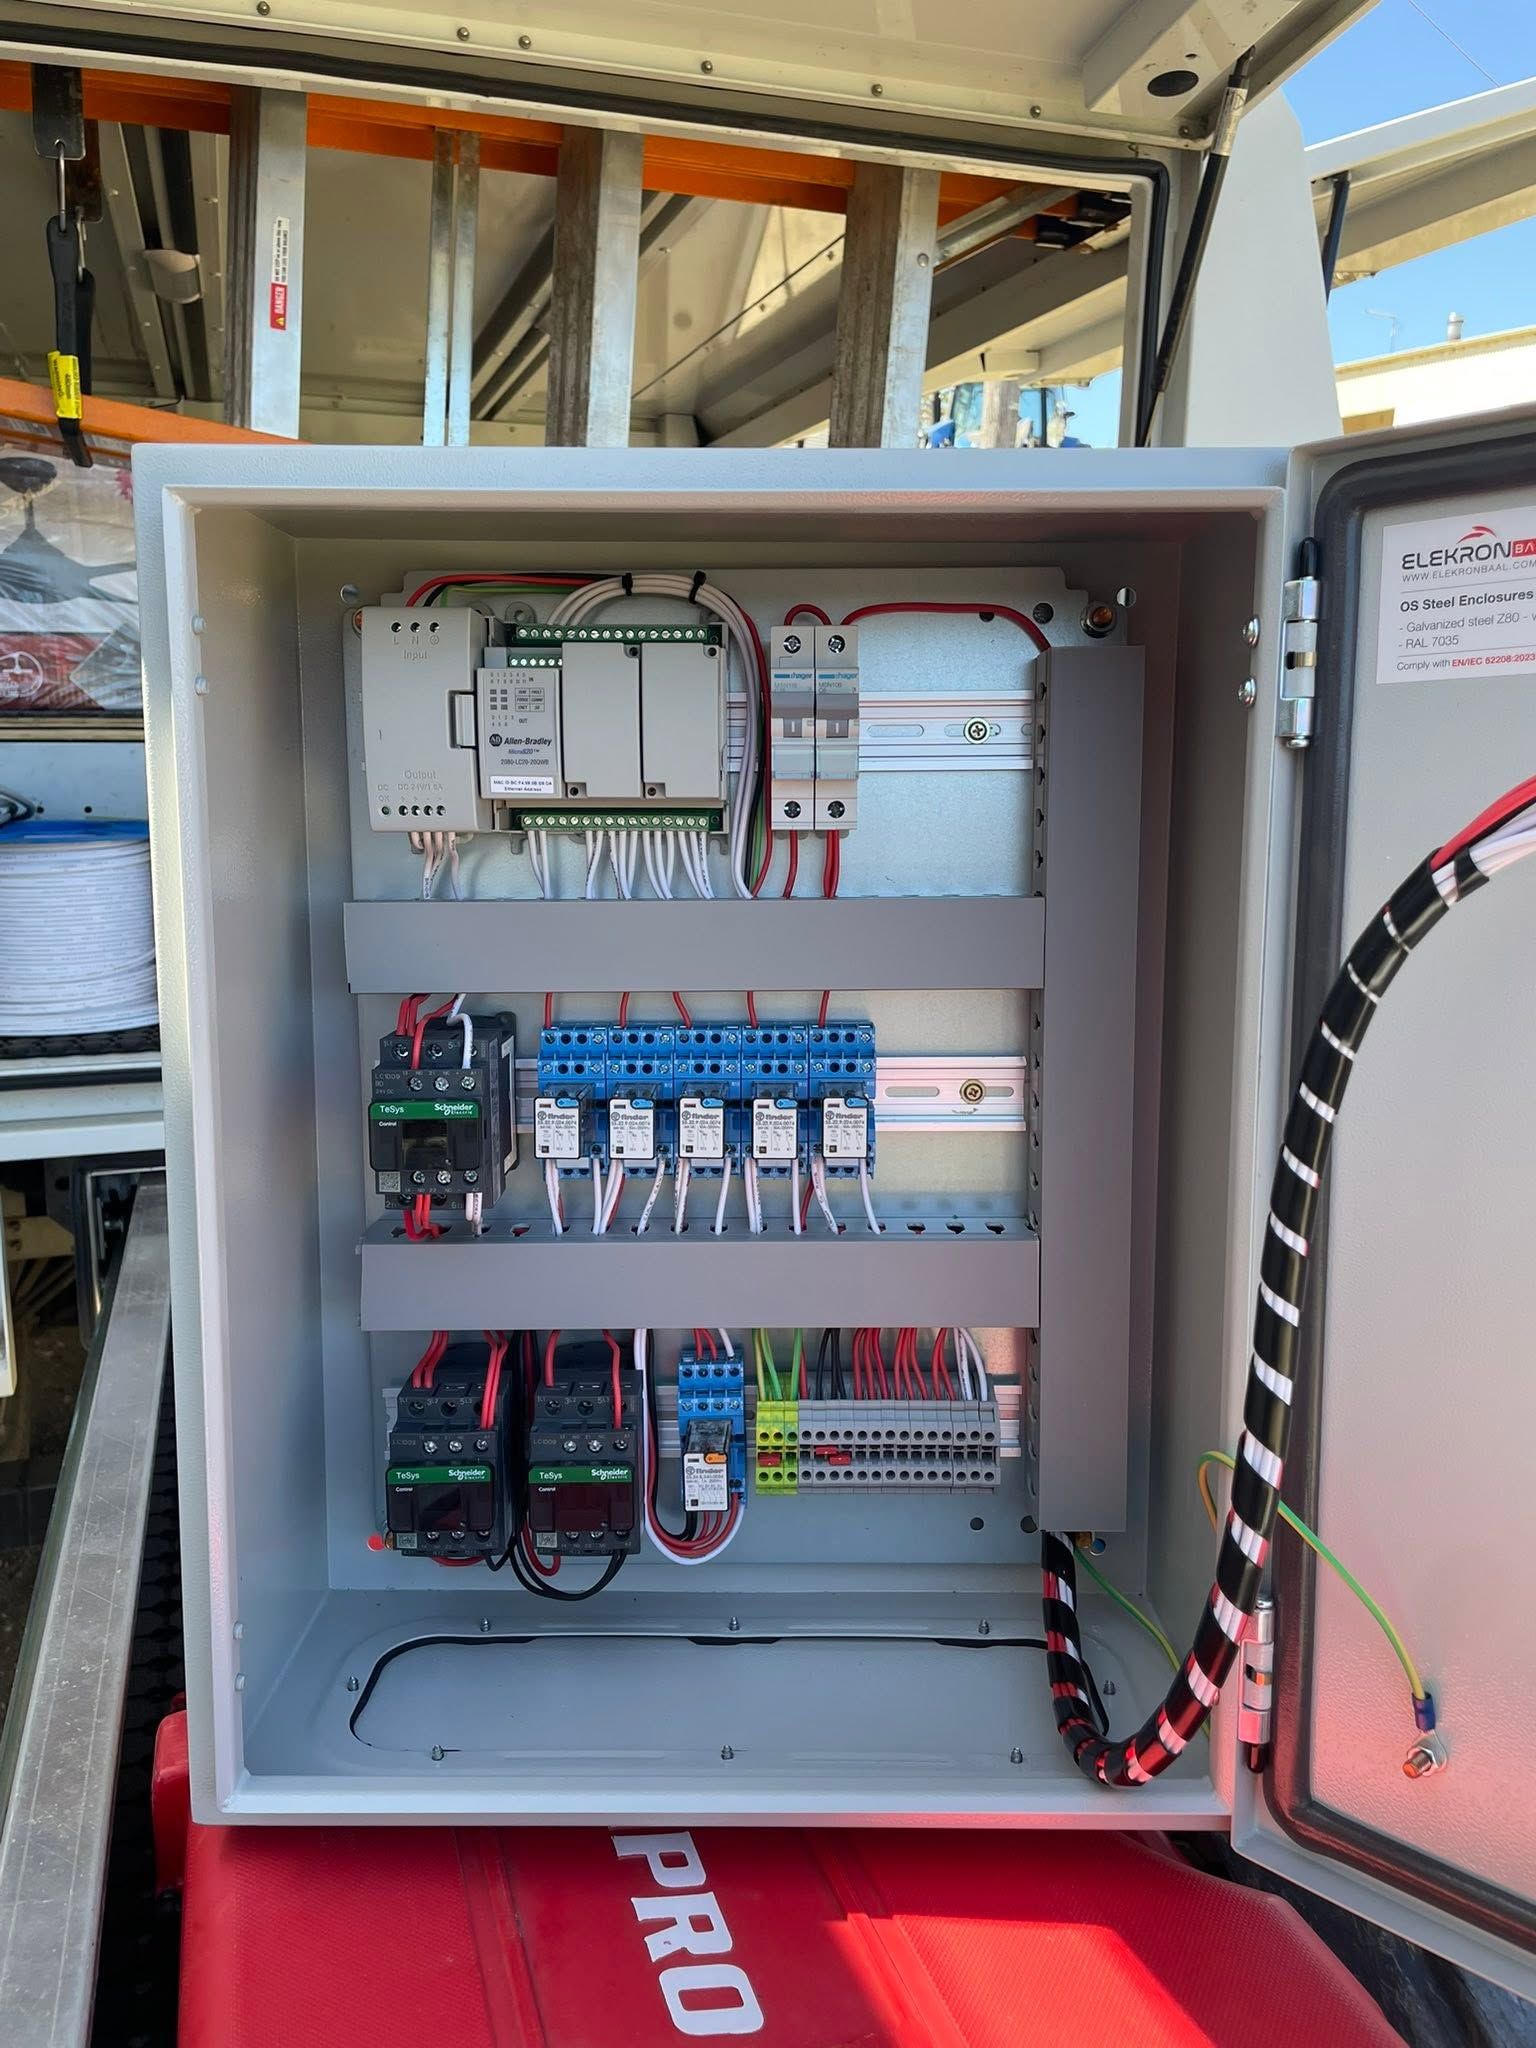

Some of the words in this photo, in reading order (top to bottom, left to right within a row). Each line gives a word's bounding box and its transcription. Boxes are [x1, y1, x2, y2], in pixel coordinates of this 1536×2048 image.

[1402, 541, 1511, 570] ELEKRON
[1400, 600, 1418, 612] OS
[1423, 597, 1455, 610] Steel
[1459, 590, 1534, 606] Enclosures
[1406, 618, 1465, 633] Galvanized
[1468, 615, 1494, 627] steel
[1497, 612, 1520, 624] Z80
[1405, 638, 1428, 649] RAL
[1432, 635, 1459, 647] 7035
[403, 649, 428, 660] Input
[1397, 660, 1430, 671] Comply
[1433, 659, 1450, 669] with
[1452, 656, 1483, 668] EN/IEC
[504, 737, 552, 747] Allen-Bradley
[379, 1106, 404, 1115] TeSys
[434, 1103, 473, 1115] Schneider
[396, 1472, 420, 1481] TeSys
[448, 1468, 486, 1480] Schneider
[539, 1472, 563, 1481] TeSys
[591, 1468, 628, 1480] Schneider
[611, 1831, 765, 2036] PRO
